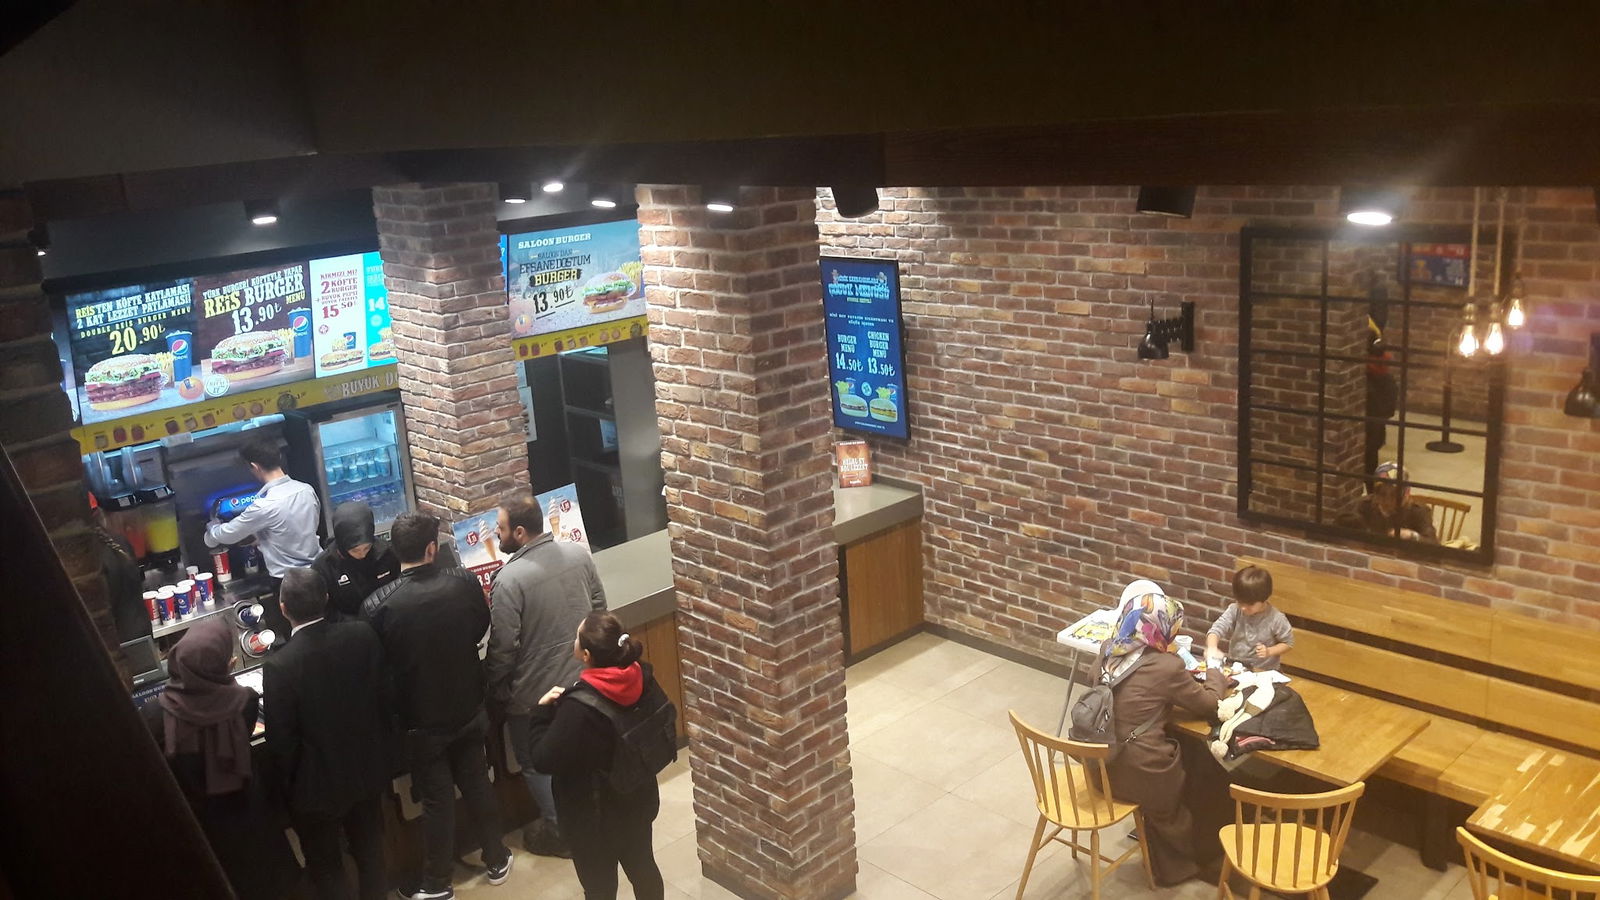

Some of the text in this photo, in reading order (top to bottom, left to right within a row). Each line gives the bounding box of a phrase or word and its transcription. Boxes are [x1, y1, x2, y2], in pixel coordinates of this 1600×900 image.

[518, 233, 591, 249] SALOON BURGER
[520, 254, 591, 274] EFSANE DOSTUM
[203, 288, 220, 299] TÜRK
[251, 271, 281, 287] KÖFTEYLE
[283, 265, 303, 277] YAPAR
[535, 269, 577, 287] BURGER
[321, 281, 330, 294] 2
[331, 285, 357, 293] BURGER
[116, 295, 142, 310] KÖFTE
[145, 283, 190, 304] KATLAMASI
[204, 273, 304, 318] REİS BURGER
[322, 304, 339, 319] 15
[368, 297, 385, 312] 14
[77, 319, 83, 329] 2
[86, 314, 104, 327] KAT
[108, 306, 138, 322] LEZZET
[81, 326, 110, 338] DOUBLE
[138, 313, 166, 325] BURGER
[837, 334, 857, 345] BURGER
[868, 331, 890, 341] CHICKEN
[870, 340, 888, 350] BURGER
[241, 494, 260, 505] peps
